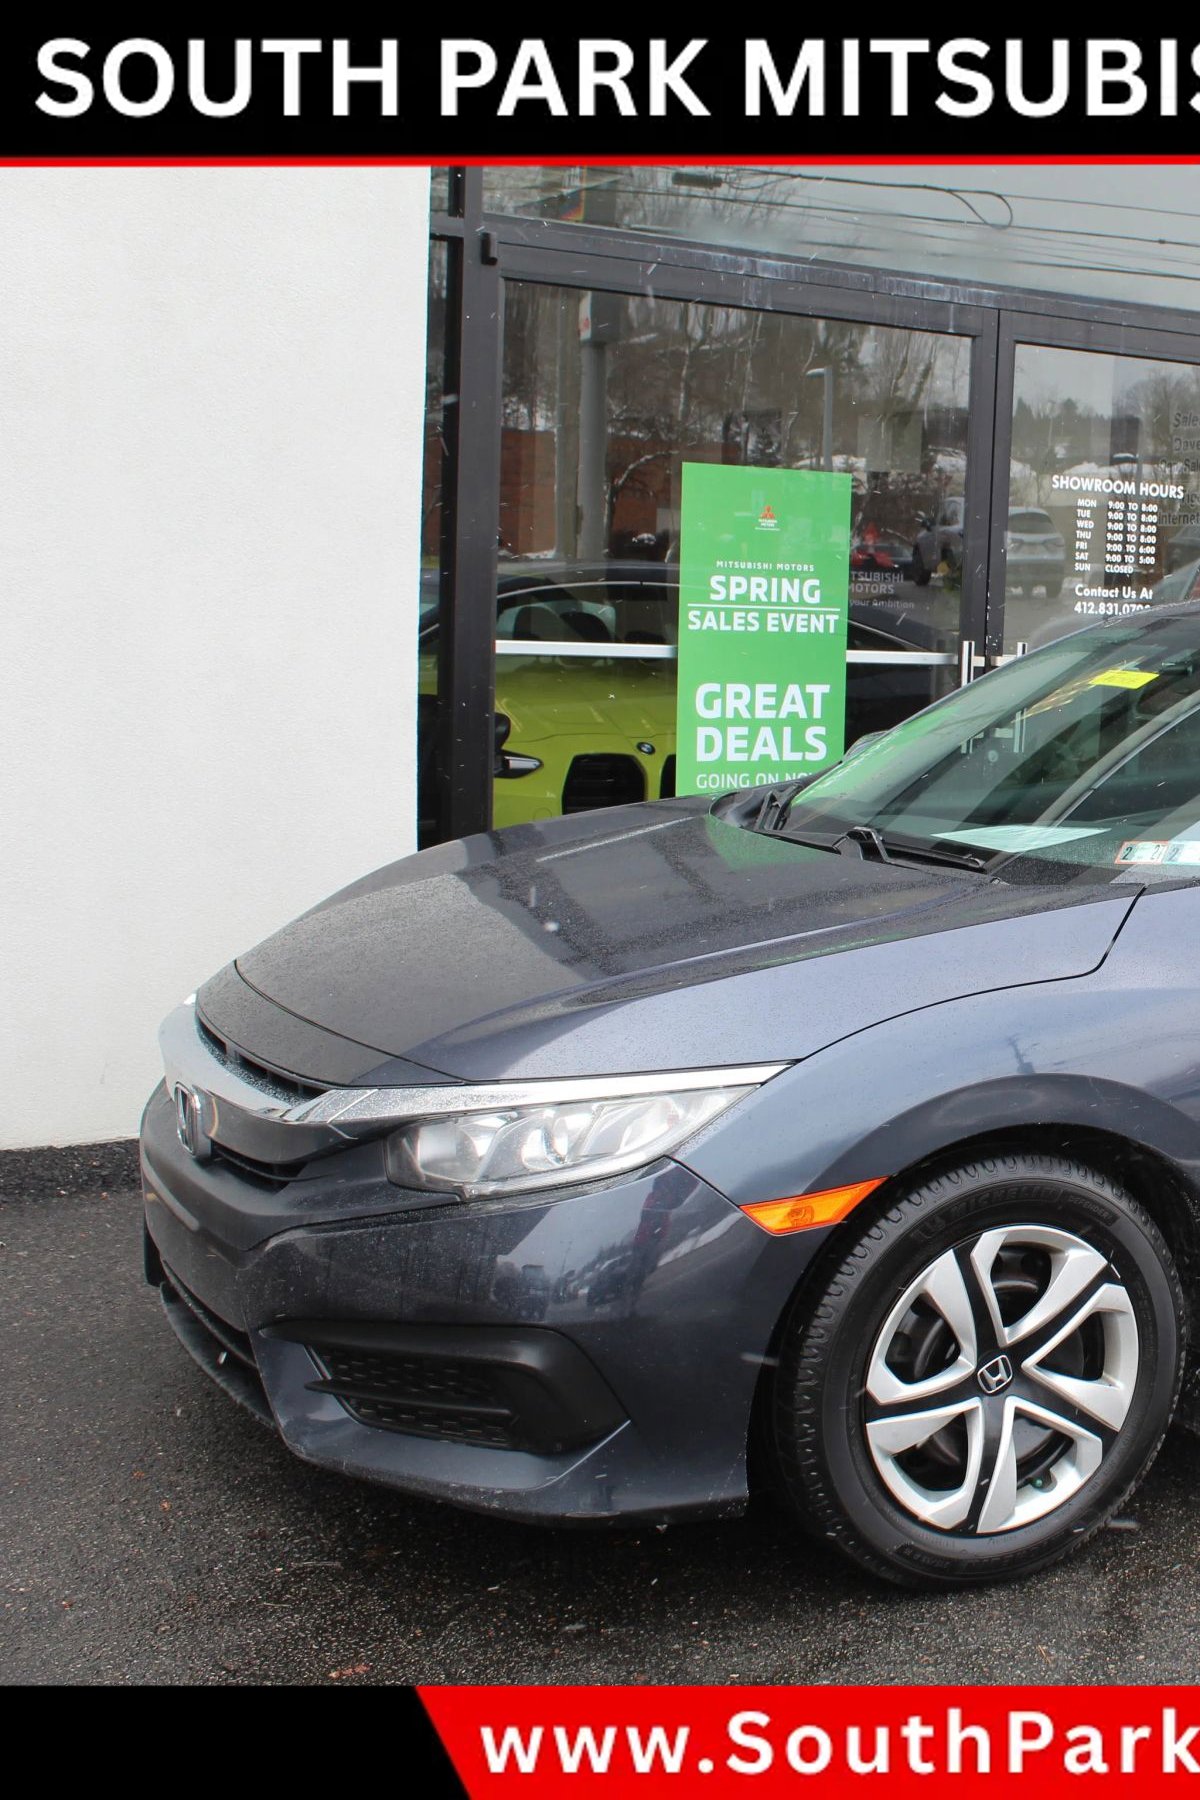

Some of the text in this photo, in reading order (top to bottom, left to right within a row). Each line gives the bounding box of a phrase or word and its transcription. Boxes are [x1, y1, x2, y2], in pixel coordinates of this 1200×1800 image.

[1052, 474, 1136, 495] SHOWROOM
[1140, 482, 1184, 499] HOURS
[1077, 499, 1158, 512] MON 9:00 TO 8:00
[1076, 509, 1157, 523] TUE 9:00 TO 8:00
[1076, 520, 1157, 533] WED 9:00 TO 8:00
[1076, 530, 1156, 544] THU 9:00 TO 8:00
[1075, 541, 1155, 554] FRI 9:00 TO 6:00
[1075, 552, 1155, 565] SAT 9:00 TO 5:00
[716, 560, 814, 572] MITSUBISHI MOTORS
[1074, 562, 1133, 574] SUN CLOSED
[851, 571, 904, 583] TSUBISHI
[709, 575, 821, 604] SPRING
[1075, 584, 1153, 599] Contact Us At
[688, 610, 839, 634] SALES EVENT
[695, 683, 830, 719] GREAT
[696, 726, 827, 762] DEALS
[696, 773, 750, 789] GOING
[1122, 846, 1133, 860] 2
